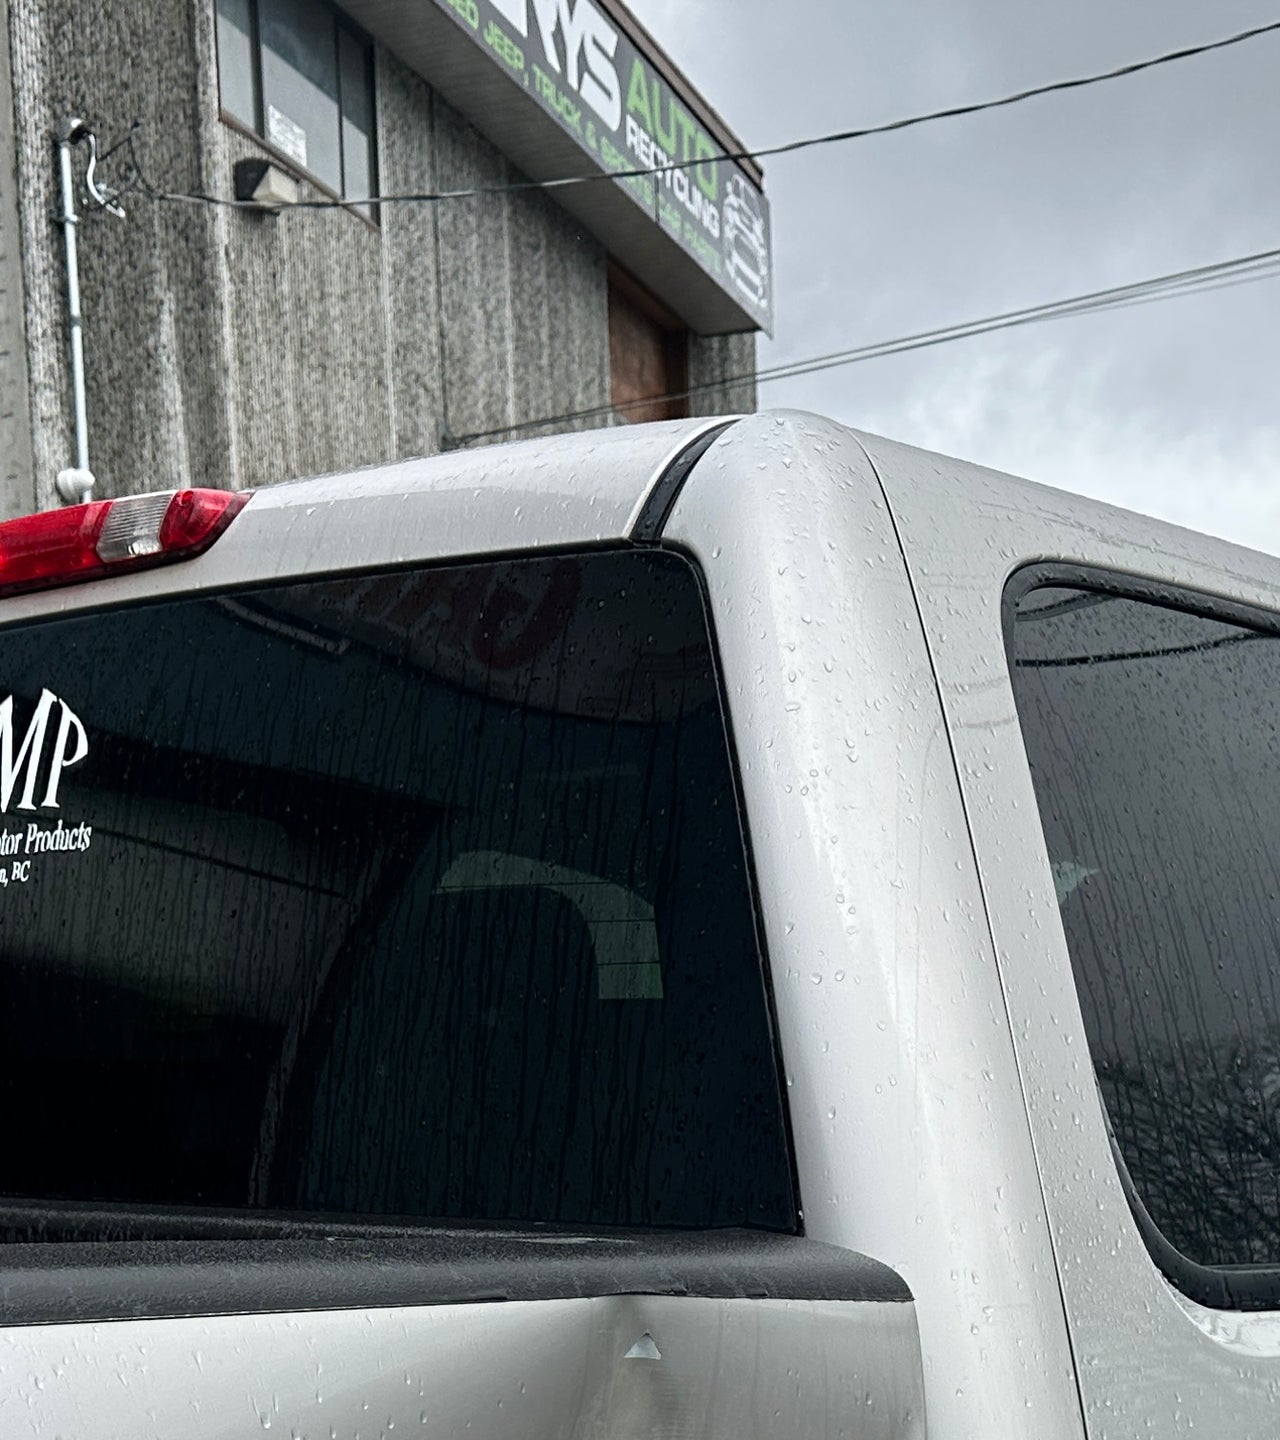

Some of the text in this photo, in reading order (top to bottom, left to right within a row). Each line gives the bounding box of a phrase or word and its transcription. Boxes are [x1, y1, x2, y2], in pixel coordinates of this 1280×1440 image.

[532, 63, 584, 136] TRUCK
[627, 58, 718, 201] AUTO
[626, 114, 720, 239] RECYCLING
[24, 819, 92, 853] Products
